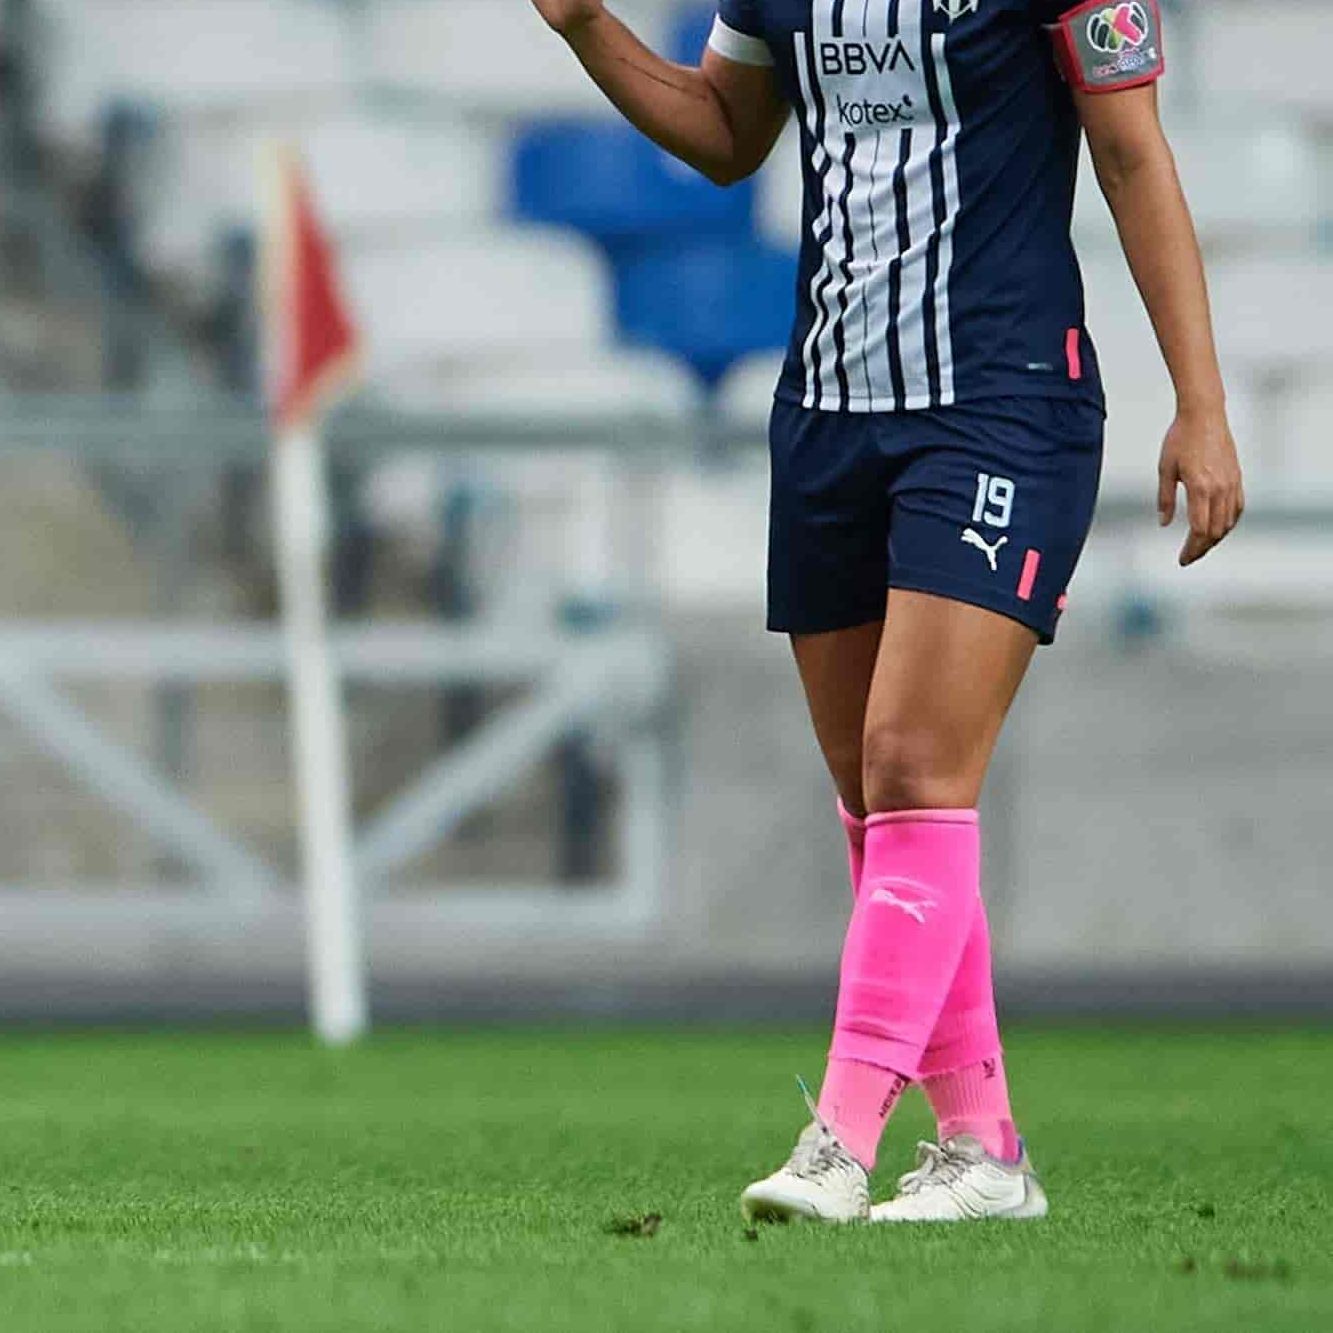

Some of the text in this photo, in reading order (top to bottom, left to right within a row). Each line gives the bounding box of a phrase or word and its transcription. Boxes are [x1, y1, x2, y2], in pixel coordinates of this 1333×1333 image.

[820, 41, 915, 74] BBVA
[836, 94, 905, 124] kotex
[972, 472, 1015, 528] 19
